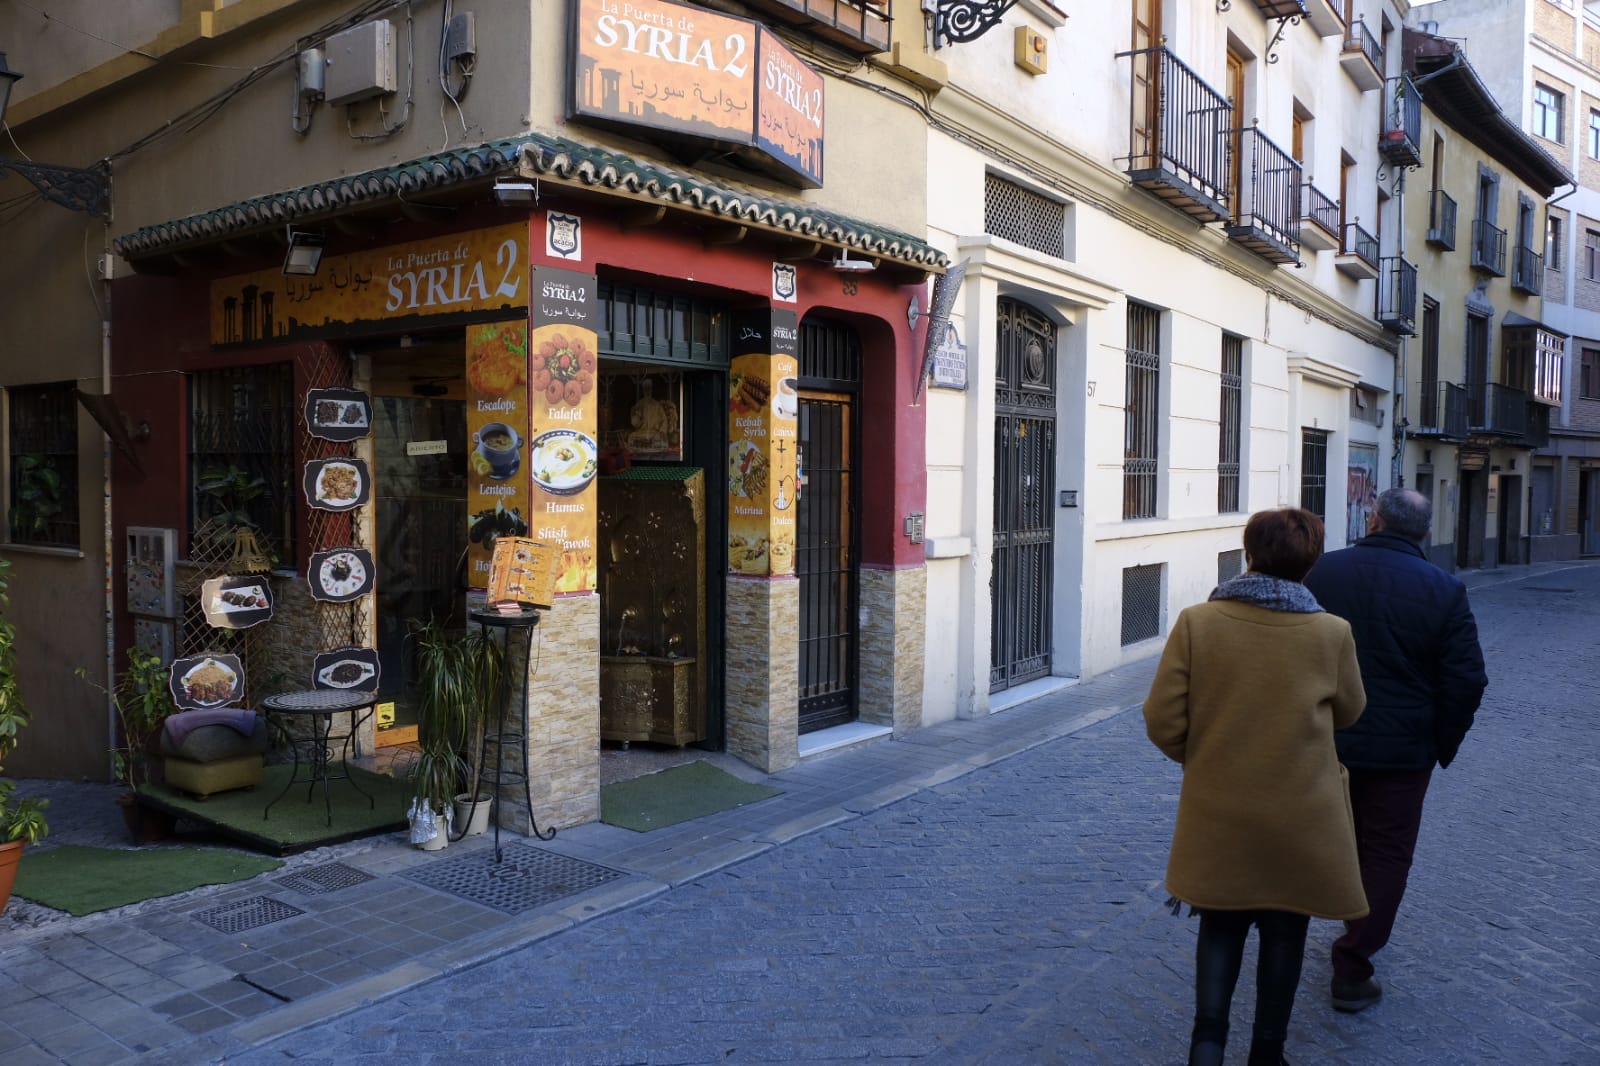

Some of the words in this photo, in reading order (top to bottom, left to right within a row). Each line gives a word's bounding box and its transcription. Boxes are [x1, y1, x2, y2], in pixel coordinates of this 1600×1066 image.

[601, 0, 618, 15] La
[623, 4, 674, 31] Puerta
[678, 16, 694, 32] de
[594, 15, 720, 71] SYRIA
[723, 33, 748, 78] 2
[630, 69, 685, 102] سوريا
[693, 81, 748, 116] بوابة
[765, 61, 810, 117] SYRIA
[812, 88, 821, 128] 2
[388, 255, 404, 271] La
[407, 249, 450, 269] Puerta
[454, 242, 469, 260] de
[329, 265, 373, 298] بوابة
[386, 261, 491, 311] SYRIA
[495, 239, 521, 298] 2
[286, 274, 323, 303] سوريا
[542, 286, 577, 301] SYRIA
[578, 287, 586, 303] 2
[542, 304, 563, 317] سوريا
[565, 306, 587, 321] بوابة
[739, 327, 762, 341] حلال
[773, 328, 792, 340] SYRIA
[792, 328, 797, 340] 2
[1087, 381, 1096, 398] 57
[477, 398, 516, 415] Escalope
[548, 407, 583, 424] Falafel
[736, 416, 762, 427] Kebab
[744, 427, 766, 439] Syrio
[479, 483, 516, 500] Lentejas
[545, 502, 584, 514] Humus
[734, 506, 764, 516] Marina
[538, 526, 568, 540] Shish
